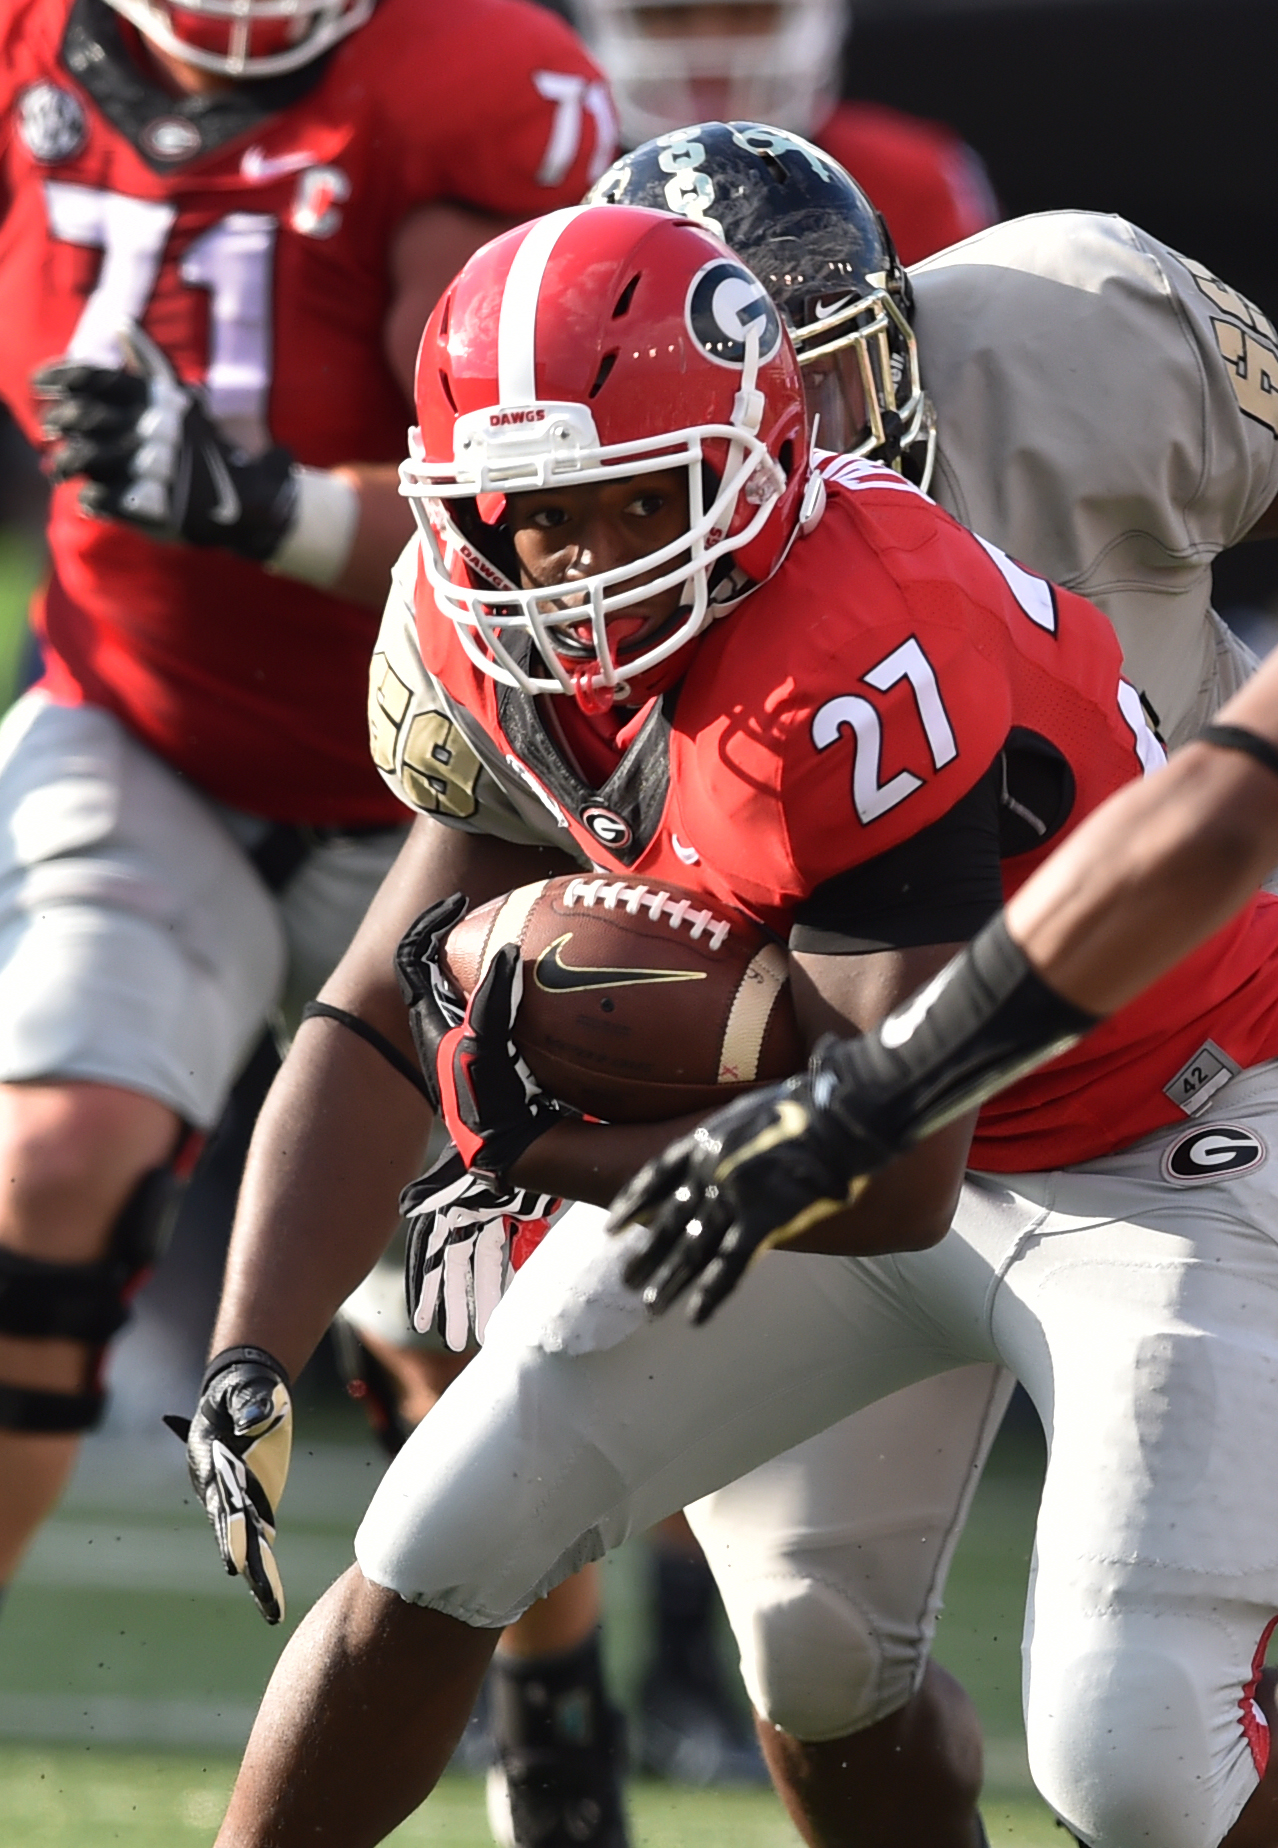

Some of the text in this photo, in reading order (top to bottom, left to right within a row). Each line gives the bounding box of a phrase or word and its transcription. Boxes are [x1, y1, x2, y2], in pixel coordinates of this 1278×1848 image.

[291, 165, 352, 240] C
[43, 179, 280, 455] 71
[489, 408, 546, 427] DAWGS
[810, 633, 959, 827] 27
[1183, 1066, 1209, 1094] 42
